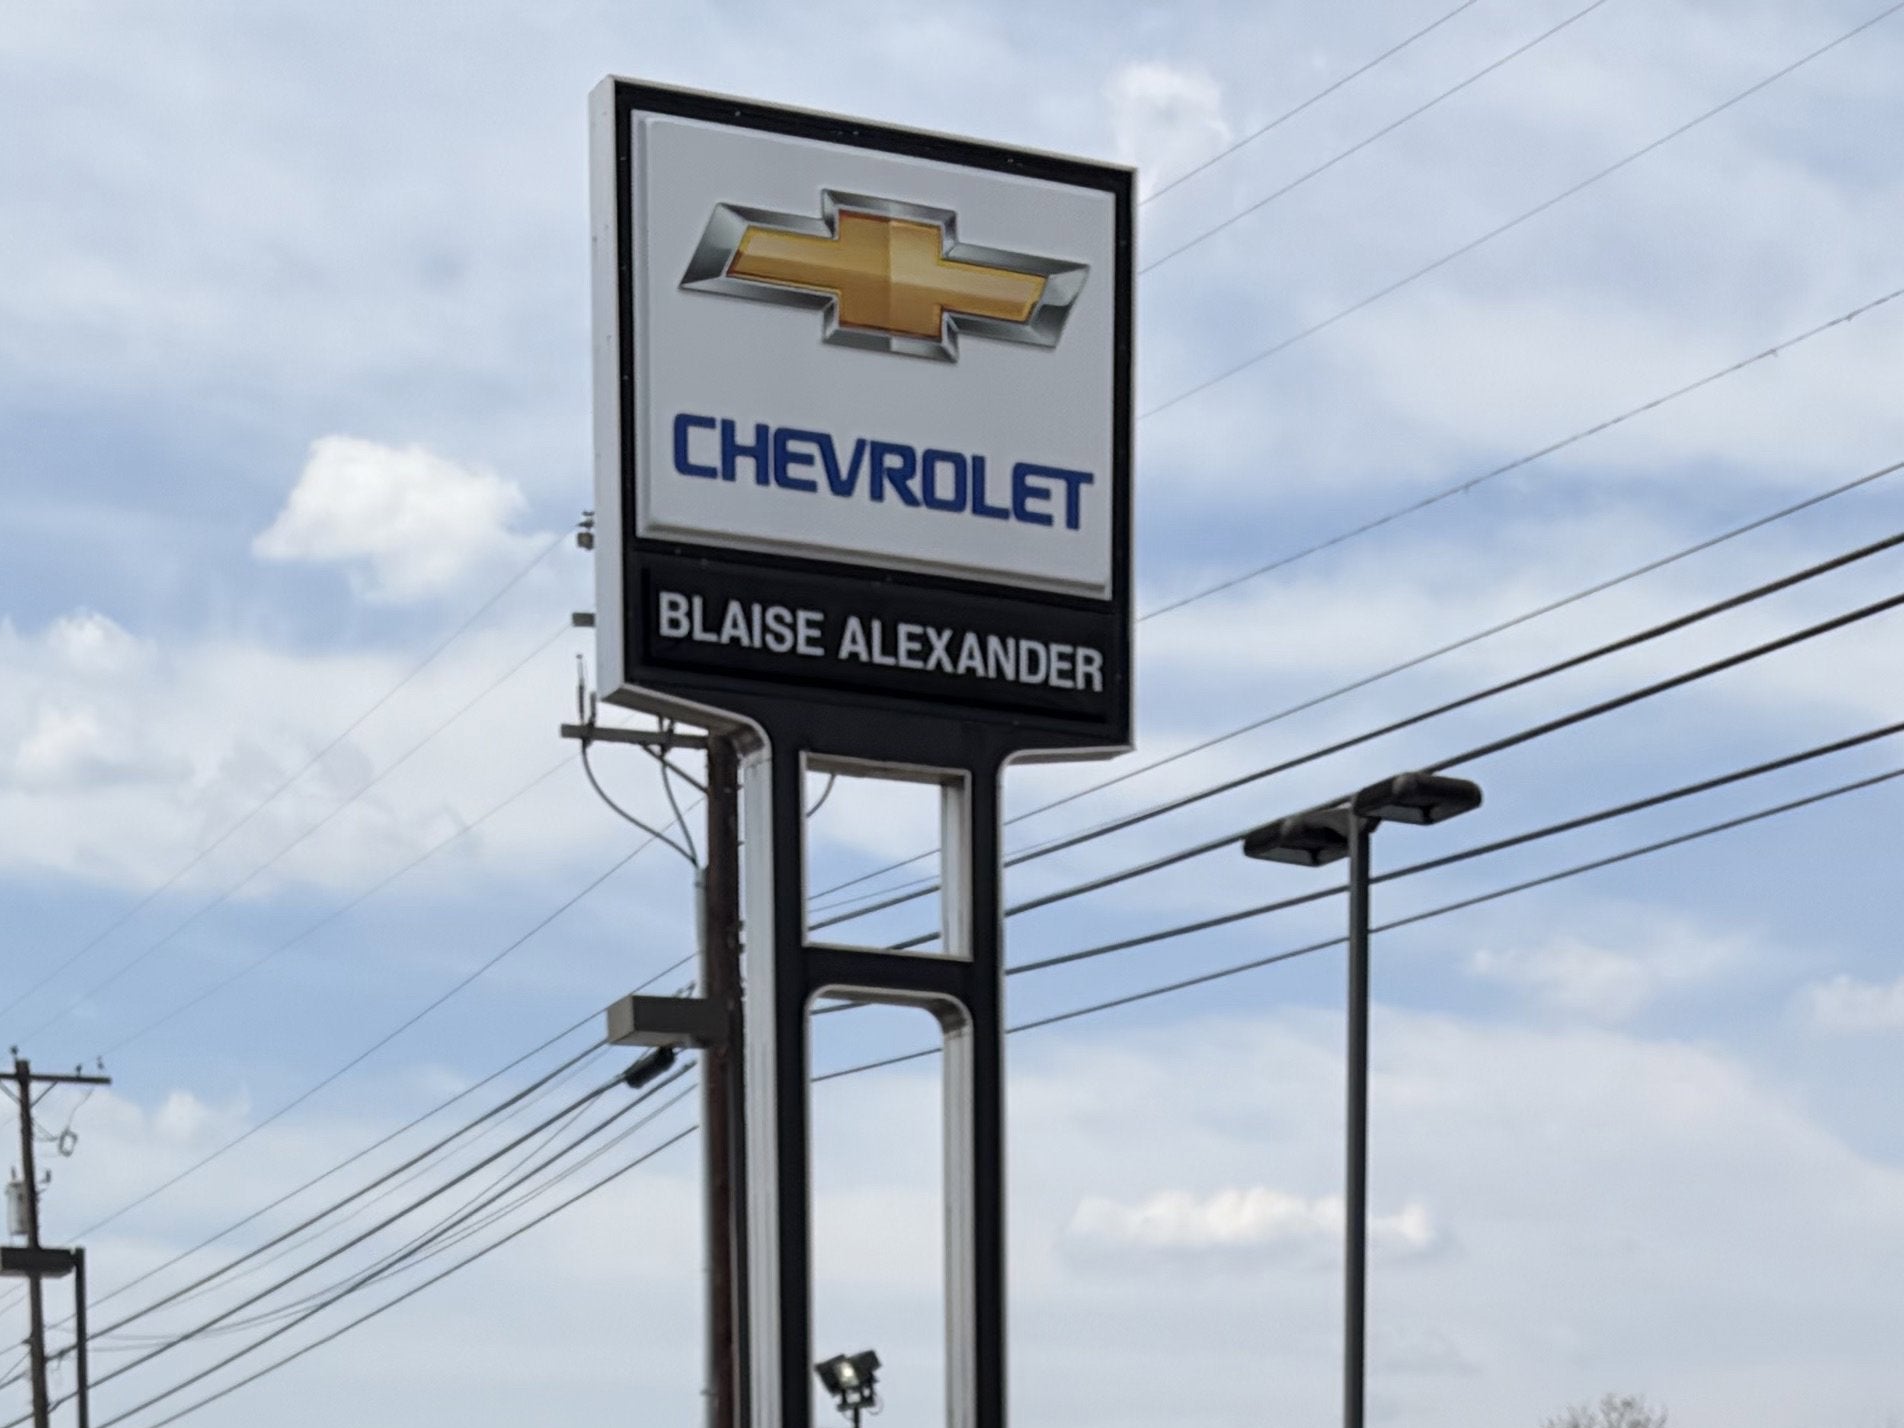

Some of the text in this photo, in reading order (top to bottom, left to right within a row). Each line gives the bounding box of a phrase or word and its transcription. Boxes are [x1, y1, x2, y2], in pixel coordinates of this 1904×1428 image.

[673, 412, 1093, 530] CHEVROLET
[658, 591, 1103, 693] BLAISE ALEXANDER
